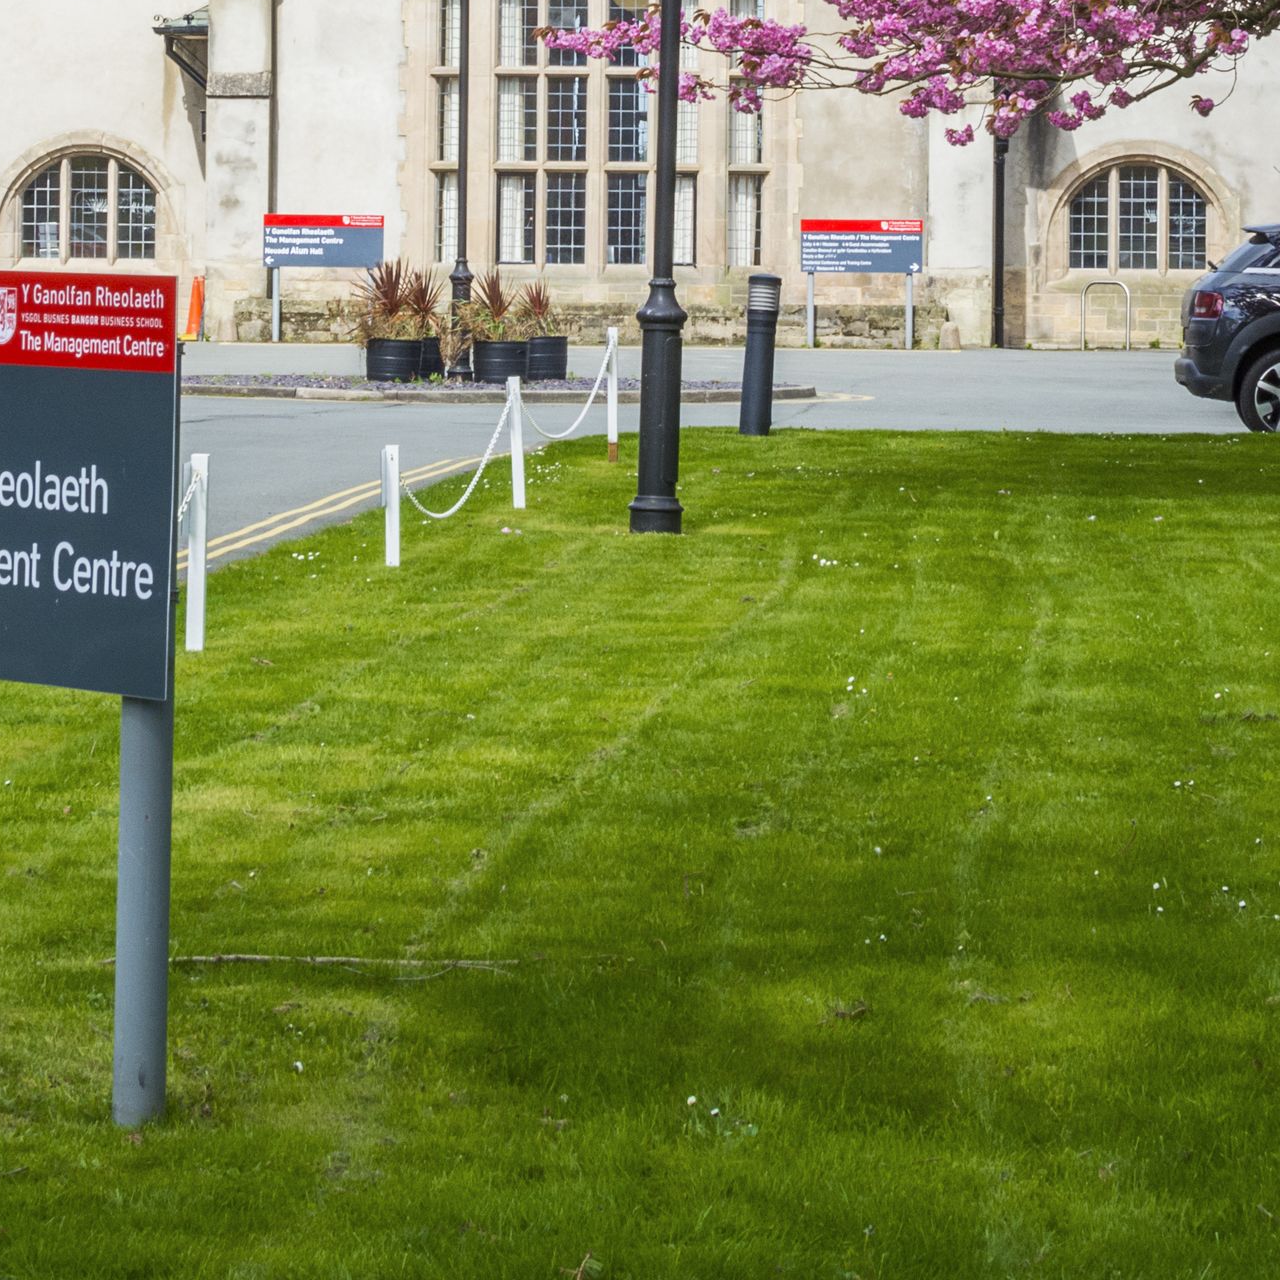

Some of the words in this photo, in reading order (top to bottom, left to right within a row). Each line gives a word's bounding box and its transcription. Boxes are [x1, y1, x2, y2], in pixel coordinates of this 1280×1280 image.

[279, 236, 320, 245] Management
[22, 284, 30, 304] Y
[33, 284, 91, 306] Ganolfan
[95, 286, 164, 309] Rheolaeth
[21, 313, 41, 323] YSGOL
[43, 314, 69, 324] BUSNES
[71, 315, 99, 326] BANGOR
[100, 316, 134, 327] BUSINESS
[136, 317, 163, 328] SCHOOL
[19, 330, 42, 351] The
[44, 332, 120, 358] Management
[123, 335, 164, 357] Centre
[52, 541, 154, 601] Centre
